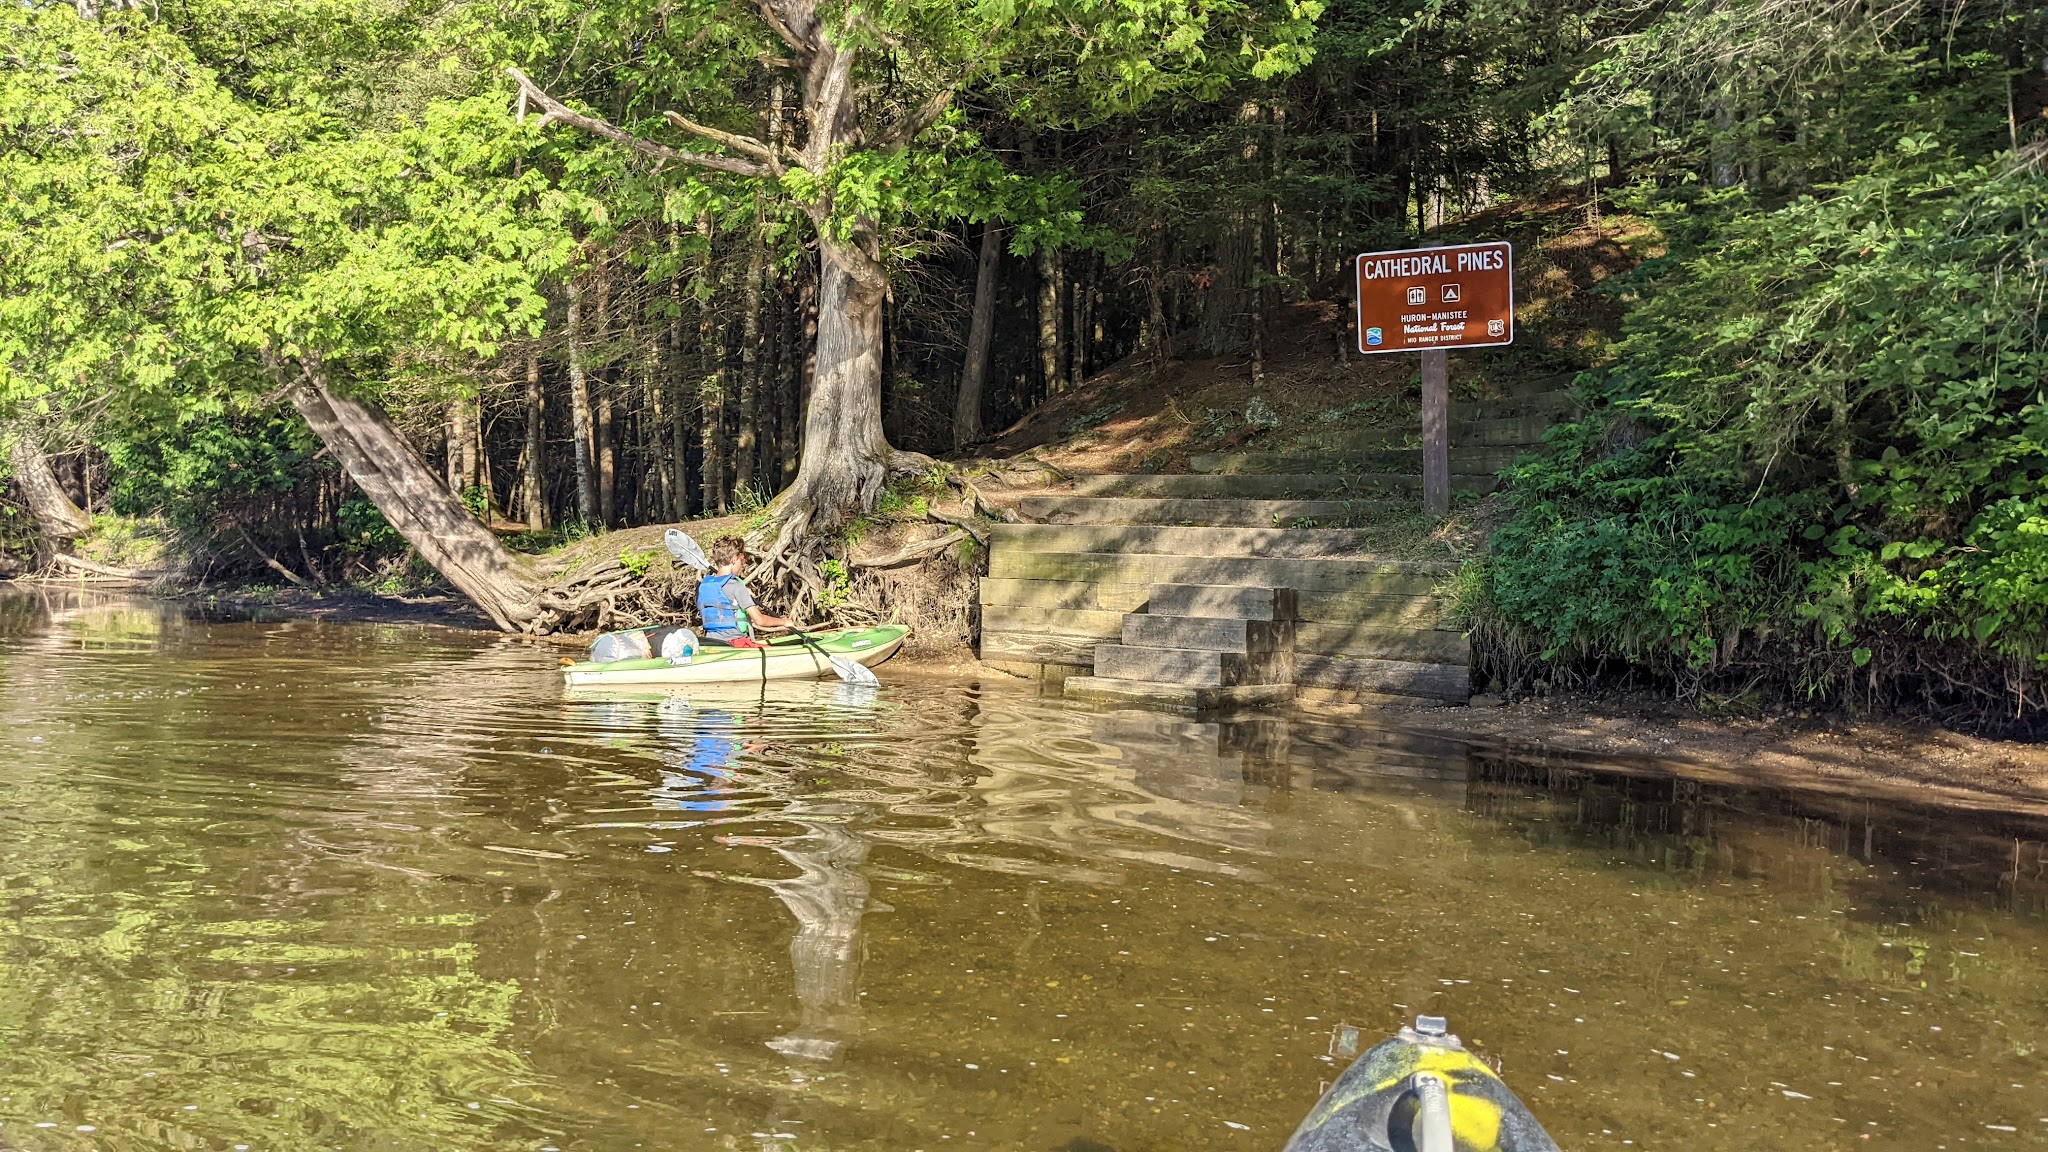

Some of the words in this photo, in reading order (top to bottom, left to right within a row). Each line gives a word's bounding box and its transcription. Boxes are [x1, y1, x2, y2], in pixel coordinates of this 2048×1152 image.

[1365, 255, 1451, 279] CATHEDRAL
[1458, 250, 1503, 272] PINES
[1401, 310, 1467, 322] HURON-MANISTEE
[1404, 322, 1437, 334] National
[1440, 322, 1465, 331] Forest
